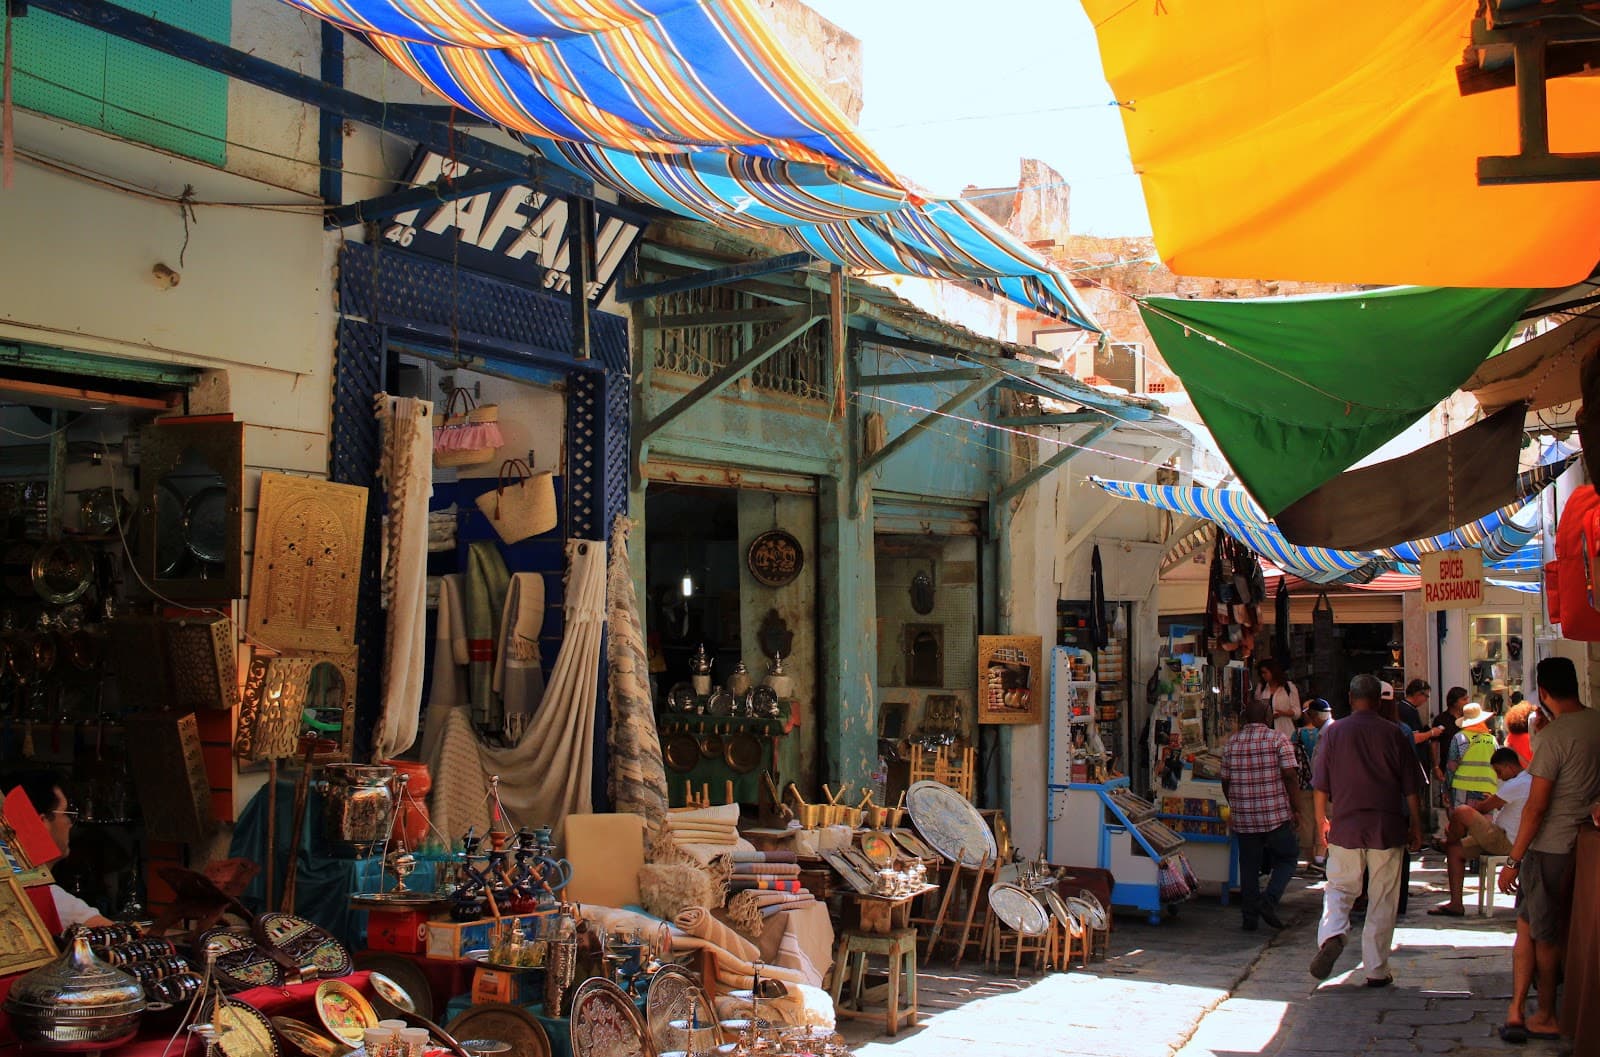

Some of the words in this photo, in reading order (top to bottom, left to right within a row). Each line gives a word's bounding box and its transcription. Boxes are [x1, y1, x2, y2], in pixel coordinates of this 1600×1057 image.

[384, 223, 418, 248] 46
[1439, 559, 1464, 580] EPICES
[1425, 580, 1481, 602] RASSHANOUT
